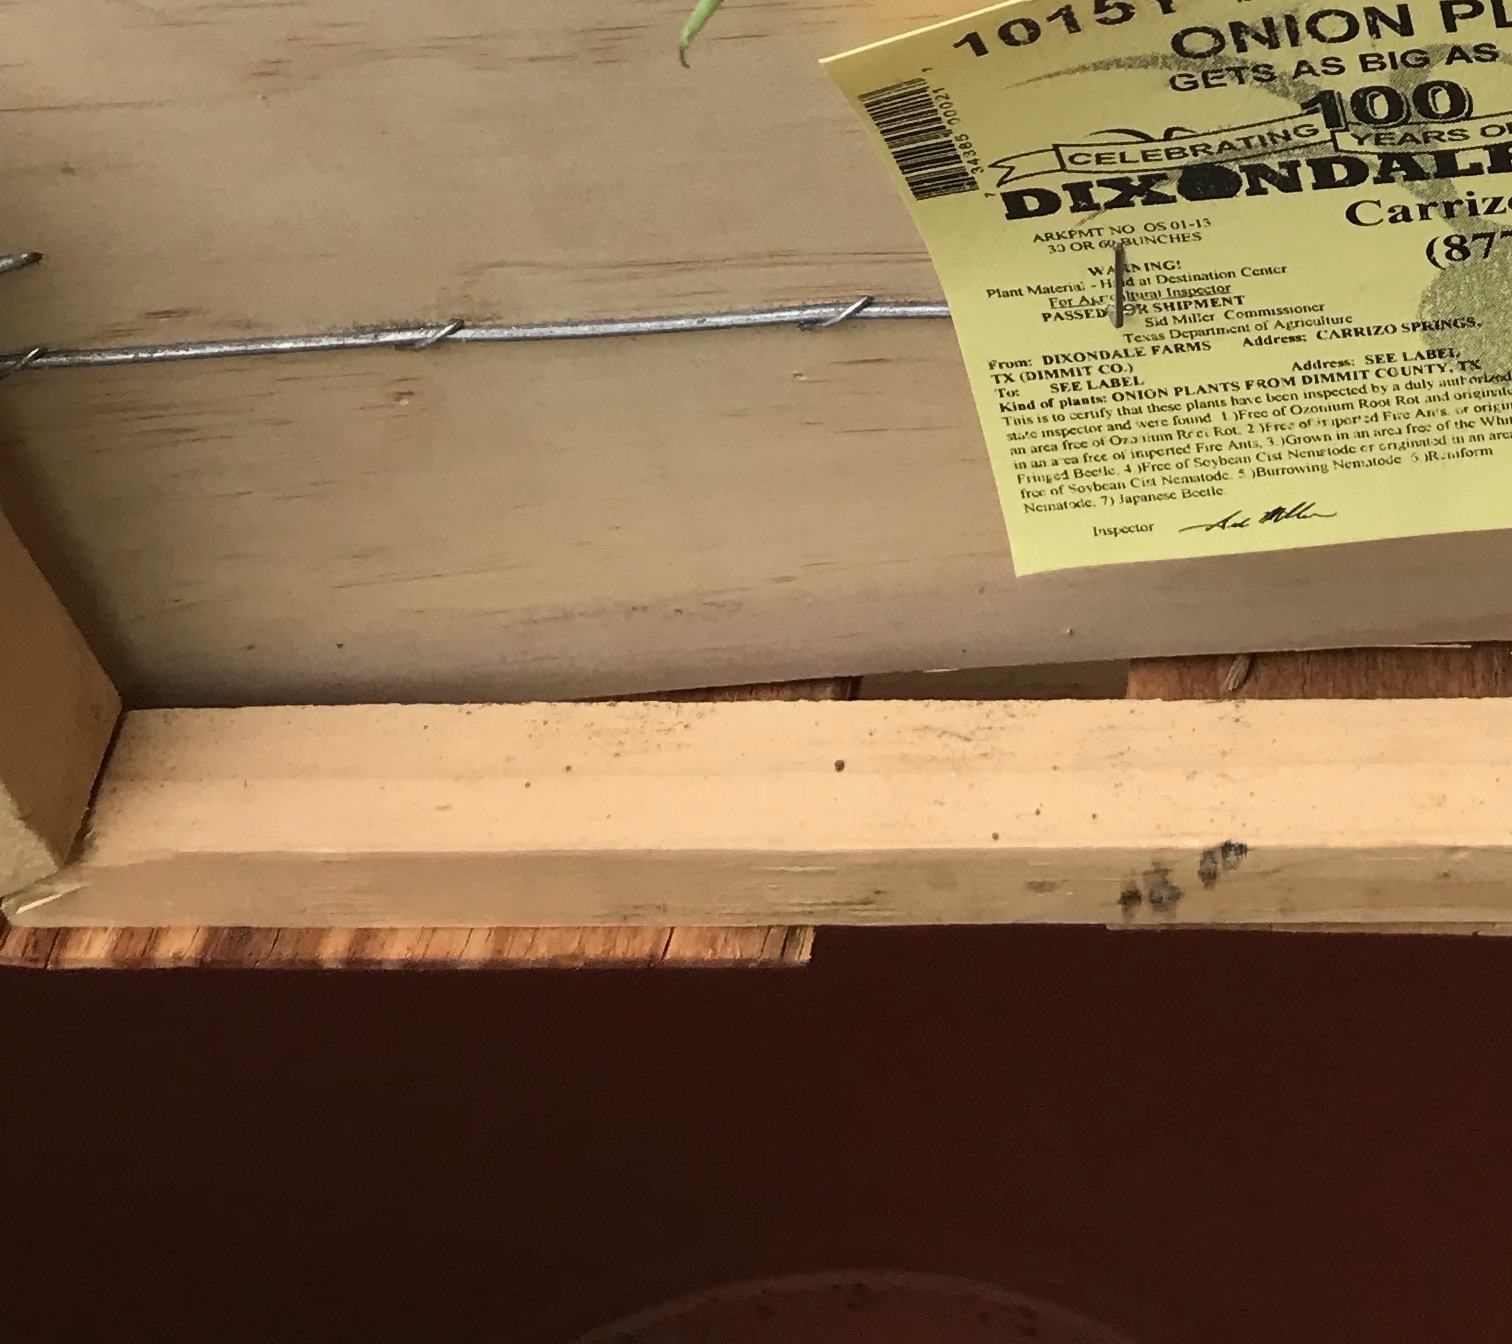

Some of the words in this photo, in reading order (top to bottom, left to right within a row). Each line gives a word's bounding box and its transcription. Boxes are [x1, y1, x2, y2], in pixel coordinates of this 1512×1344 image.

[1170, 2, 1415, 60] ONION
[1169, 63, 1278, 93] GETS
[1292, 56, 1346, 80] AS
[1358, 48, 1430, 74] BIG
[1445, 42, 1500, 65] AS
[1301, 79, 1474, 133] 100
[1068, 123, 1320, 169] CELEBRATING
[1350, 127, 1472, 147] YEARS
[1109, 223, 1136, 236] NO
[1170, 217, 1212, 230] 01-13
[1070, 240, 1095, 253] OR
[1120, 231, 1203, 247] BUNCHES
[986, 286, 1024, 299] Plant
[1156, 268, 1237, 284] Destination
[1042, 307, 1108, 323] PASSED
[1152, 295, 1246, 313] SHIPMENT
[1049, 296, 1074, 308] For
[988, 358, 1033, 371] From:
[1042, 345, 1147, 366] DIXONDALE
[1151, 340, 1212, 356] FARMS
[1316, 323, 1398, 341] CARRIZO
[1123, 330, 1164, 344] Texas
[1169, 324, 1251, 342] Department
[991, 372, 1016, 385] TX
[1019, 365, 1093, 383] (DIMMIT
[1000, 399, 1036, 413] Kind
[1040, 397, 1055, 410] of
[1059, 394, 1108, 409] plants:
[1111, 387, 1169, 402] ONION
[1173, 380, 1241, 398] PLANTS
[1244, 376, 1297, 391] FROM
[1301, 368, 1371, 386] DIMMIT
[1457, 358, 1482, 373] TX
[1050, 379, 1083, 394] SEE
[1087, 375, 1145, 391] LABEL
[1364, 352, 1399, 366] SEE
[1037, 413, 1049, 424] is
[1052, 411, 1066, 422] to
[1117, 404, 1144, 417] that
[1186, 398, 1228, 413] plants
[1106, 419, 1132, 432] and
[1092, 523, 1155, 538] Inspector
